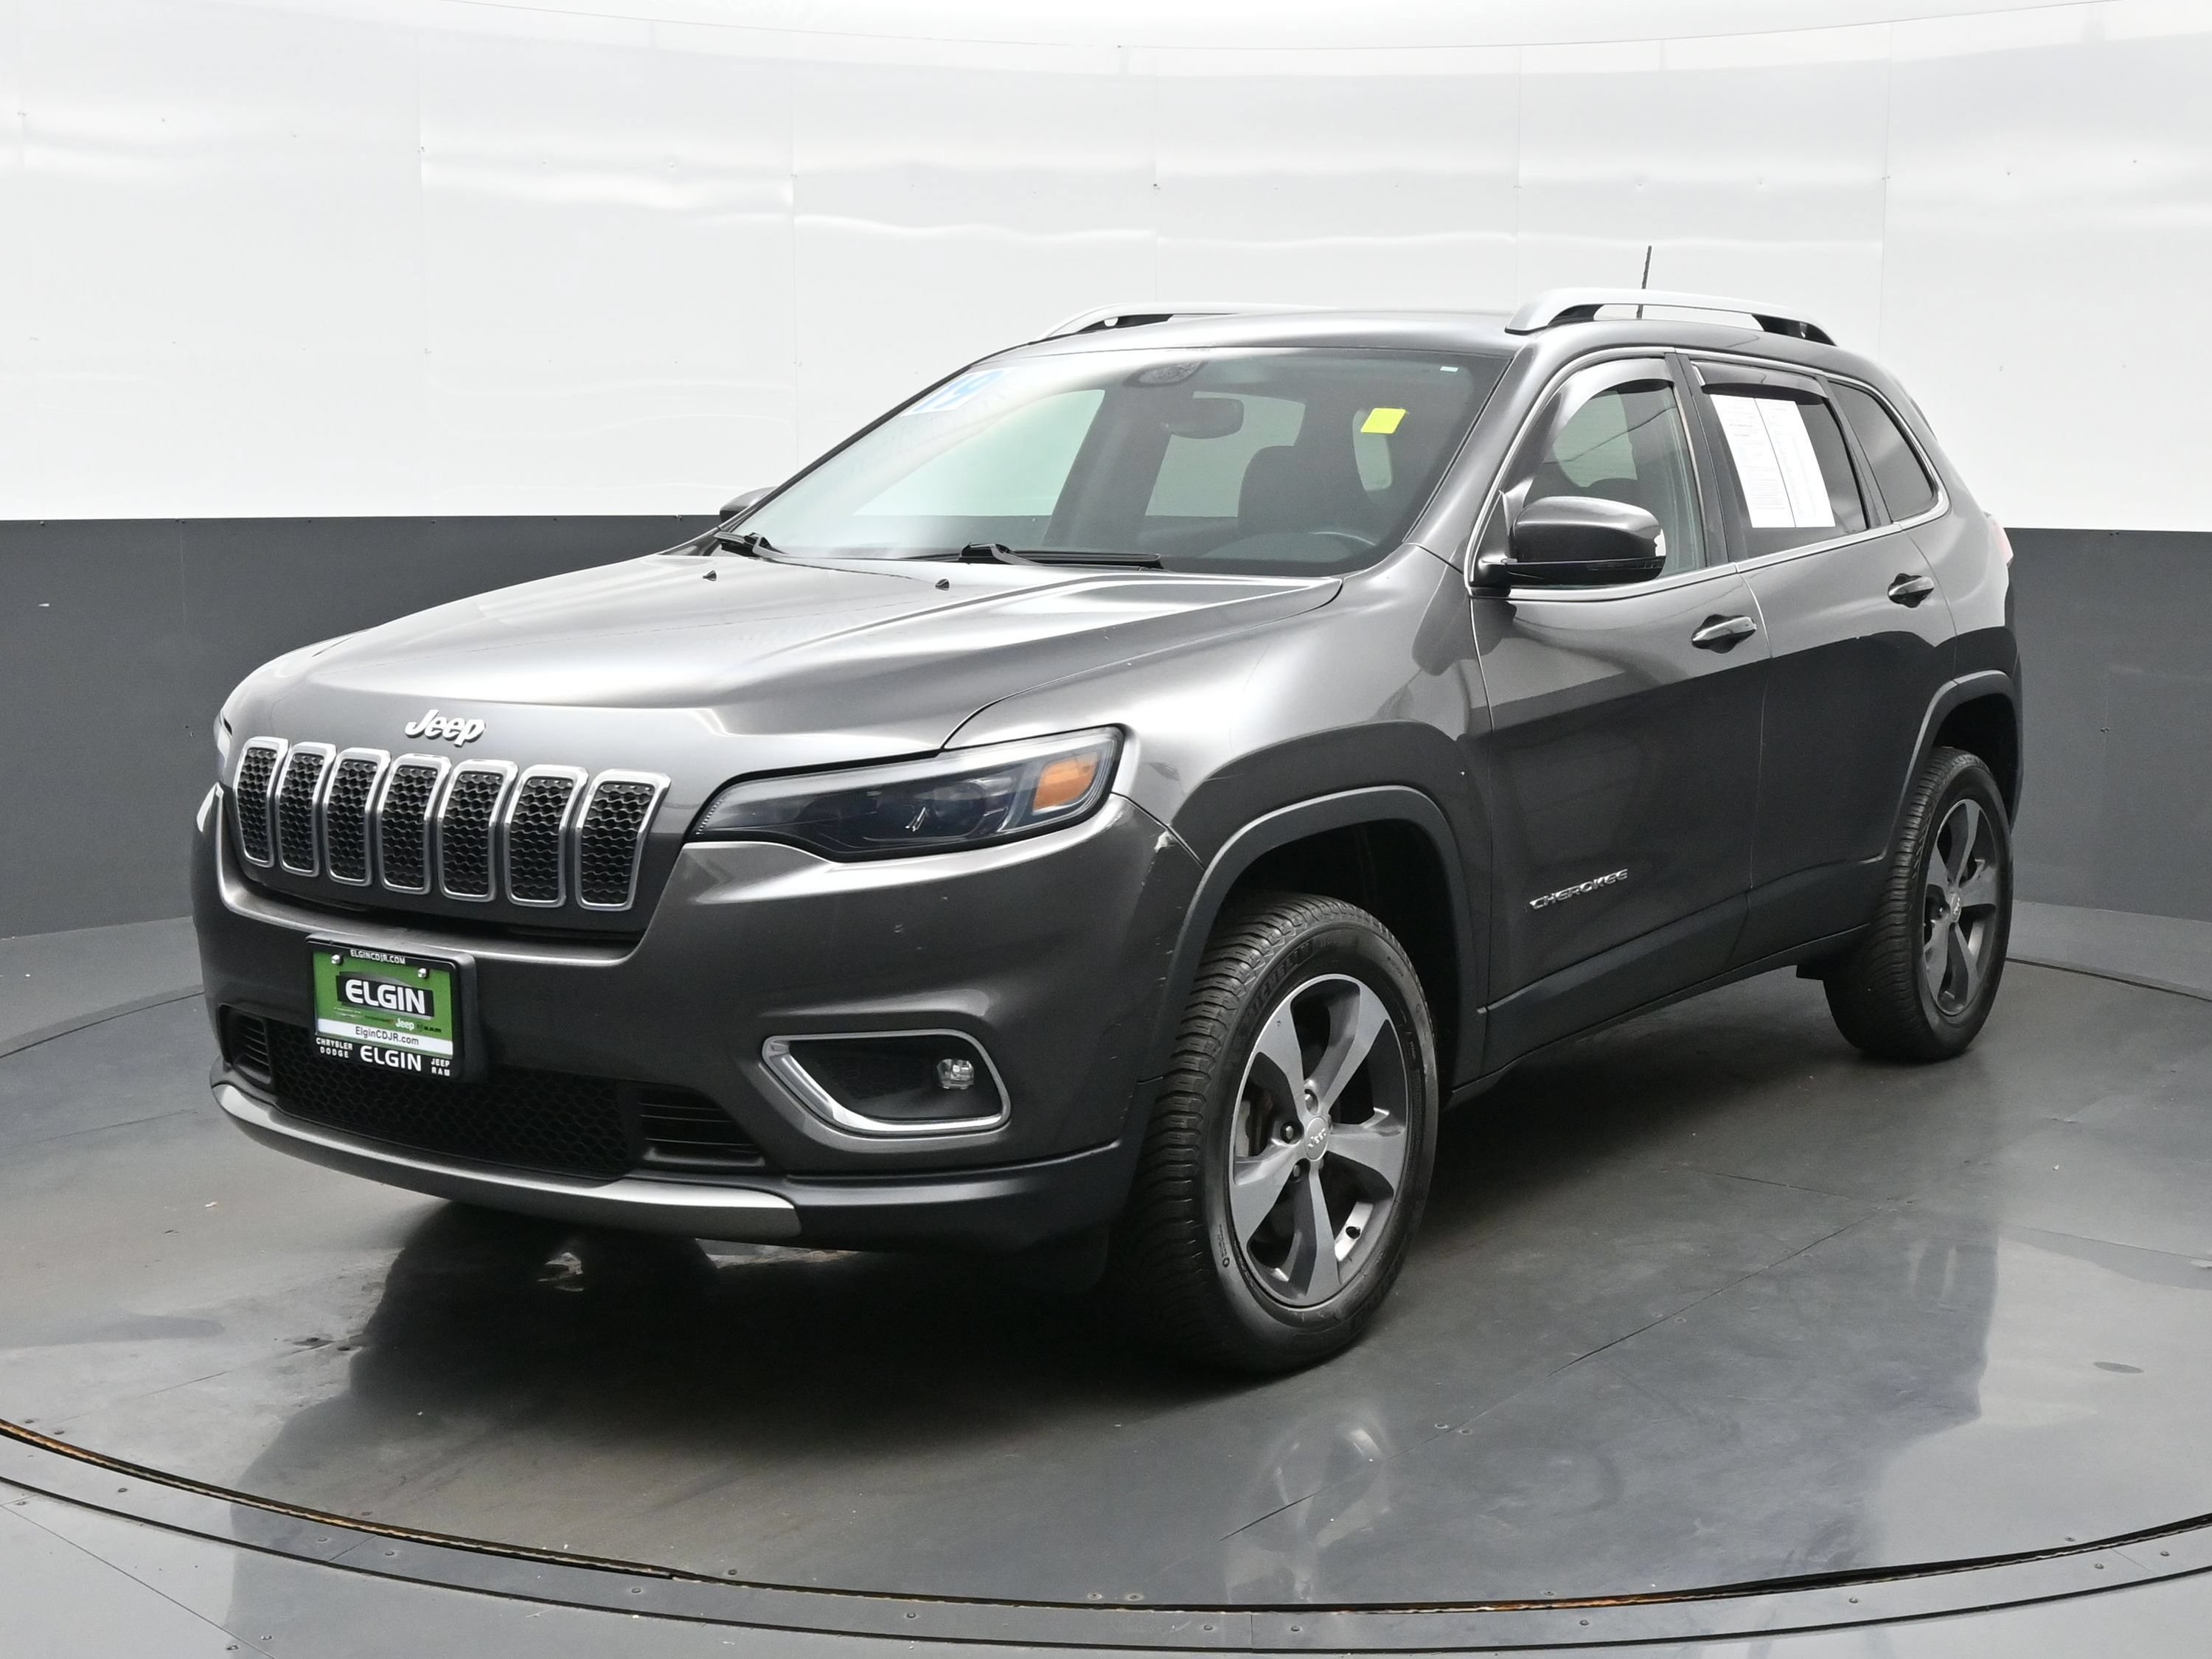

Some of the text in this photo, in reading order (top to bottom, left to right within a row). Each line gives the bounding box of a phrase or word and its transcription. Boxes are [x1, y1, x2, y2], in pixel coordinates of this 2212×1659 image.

[405, 709, 486, 748] Jeep
[1529, 869, 1628, 909] CHEROKEE
[350, 950, 406, 964] ELGINCDJR.COM
[345, 978, 425, 1015] ELGIN
[395, 1018, 415, 1031] Jeep
[355, 1026, 419, 1046] ElginCDJR.com
[316, 1037, 353, 1051] CHRYSLER
[320, 1046, 349, 1059] DODGE
[360, 1045, 421, 1072] ELGIN
[431, 1058, 451, 1068] JEEP
[431, 1067, 451, 1077] RAM
